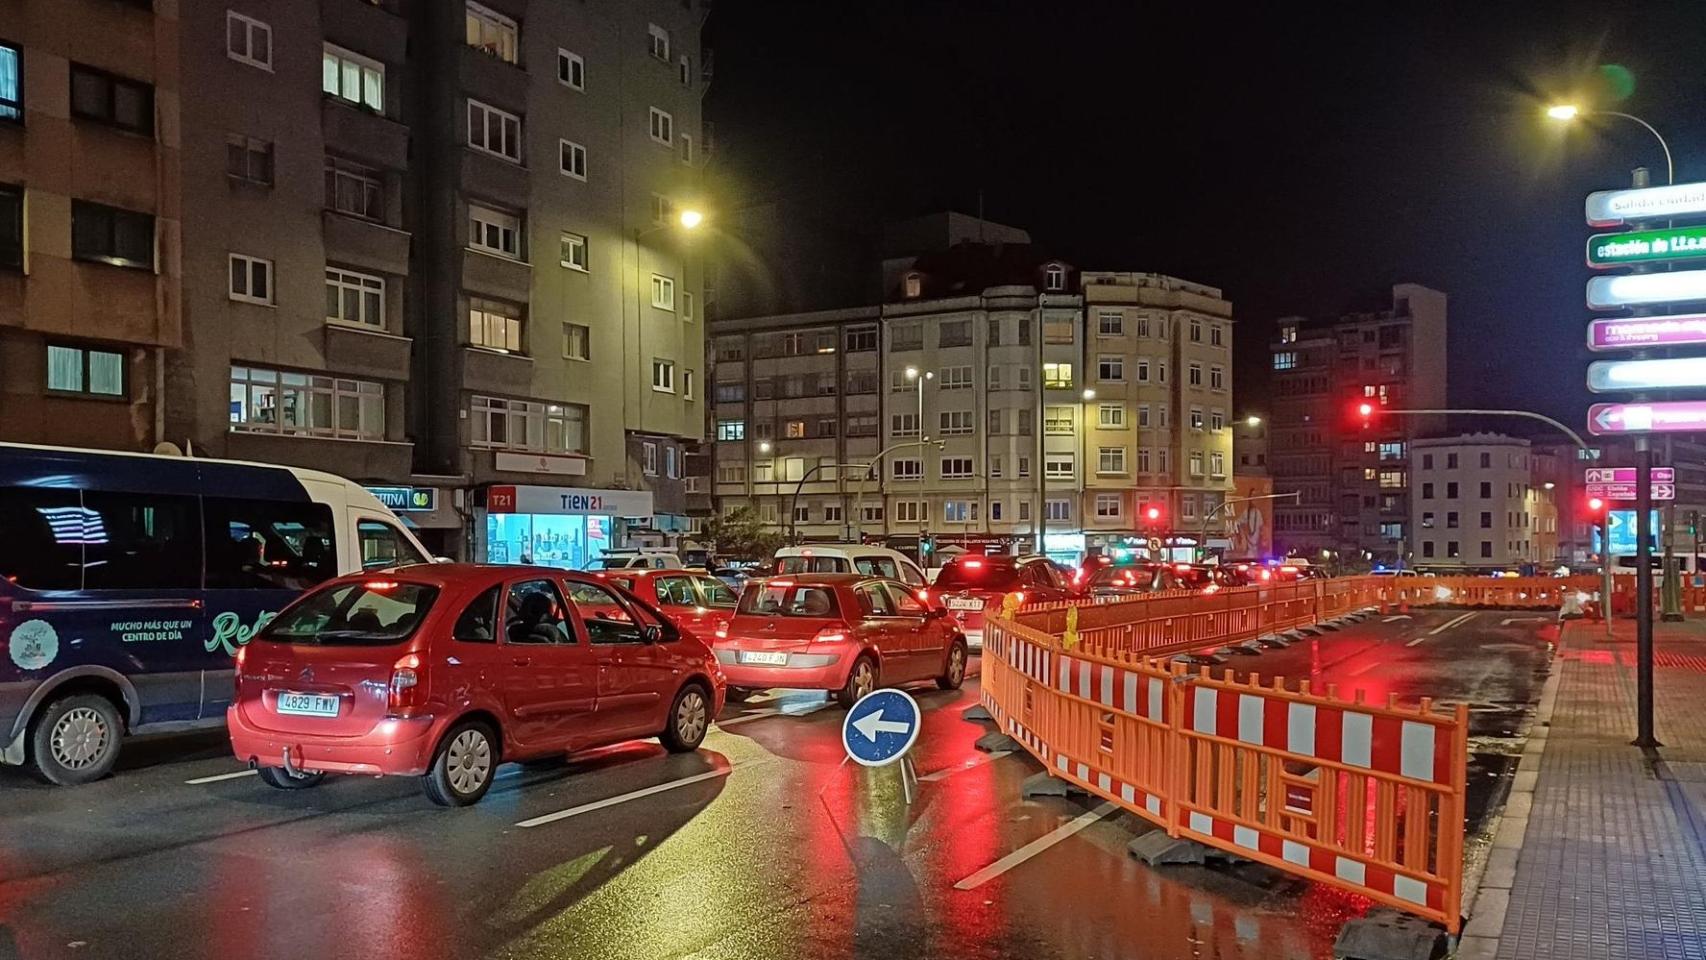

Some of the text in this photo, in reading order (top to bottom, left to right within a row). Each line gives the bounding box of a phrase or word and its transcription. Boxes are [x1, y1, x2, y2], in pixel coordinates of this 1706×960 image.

[493, 495, 511, 507] T21
[111, 621, 143, 631] MUCHO
[163, 620, 179, 629] QUE
[180, 620, 192, 629] UN
[122, 630, 183, 642] CENTRO DE DÍA
[285, 696, 310, 710] 4829
